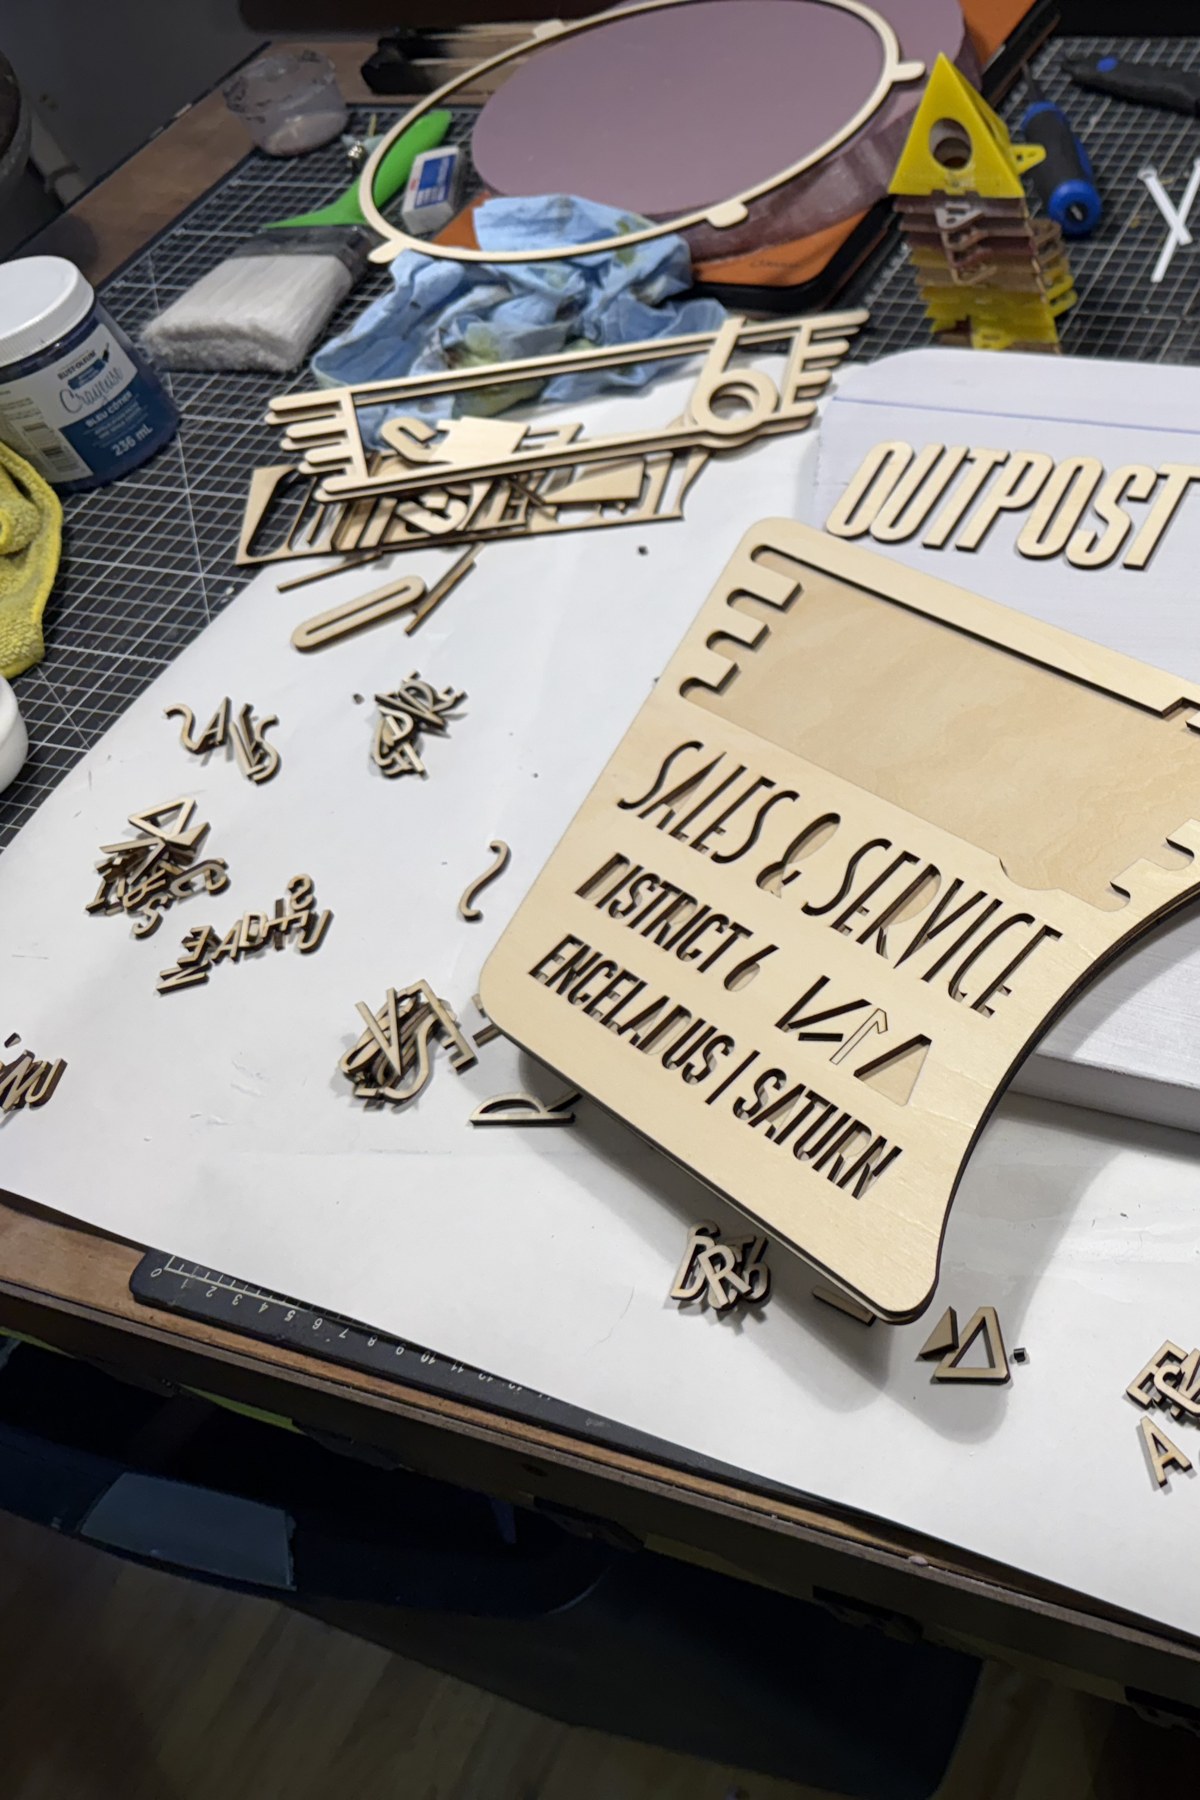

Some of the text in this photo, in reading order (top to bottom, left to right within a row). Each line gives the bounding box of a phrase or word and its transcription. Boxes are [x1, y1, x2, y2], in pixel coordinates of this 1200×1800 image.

[112, 435, 137, 457] 236
[136, 423, 154, 442] mL
[574, 852, 780, 993] DISTRICT 6
[617, 740, 1064, 1019] SALES & SERVICE
[527, 933, 736, 1088] ENCELADUS
[733, 1067, 903, 1200] SATURN
[150, 1267, 163, 1278] 0
[180, 1277, 189, 1290] 1
[206, 1285, 218, 1298] 2
[231, 1293, 243, 1306] 3
[258, 1301, 269, 1314] 4
[284, 1309, 296, 1322] 5
[312, 1317, 323, 1330] 6
[338, 1327, 350, 1339] 7
